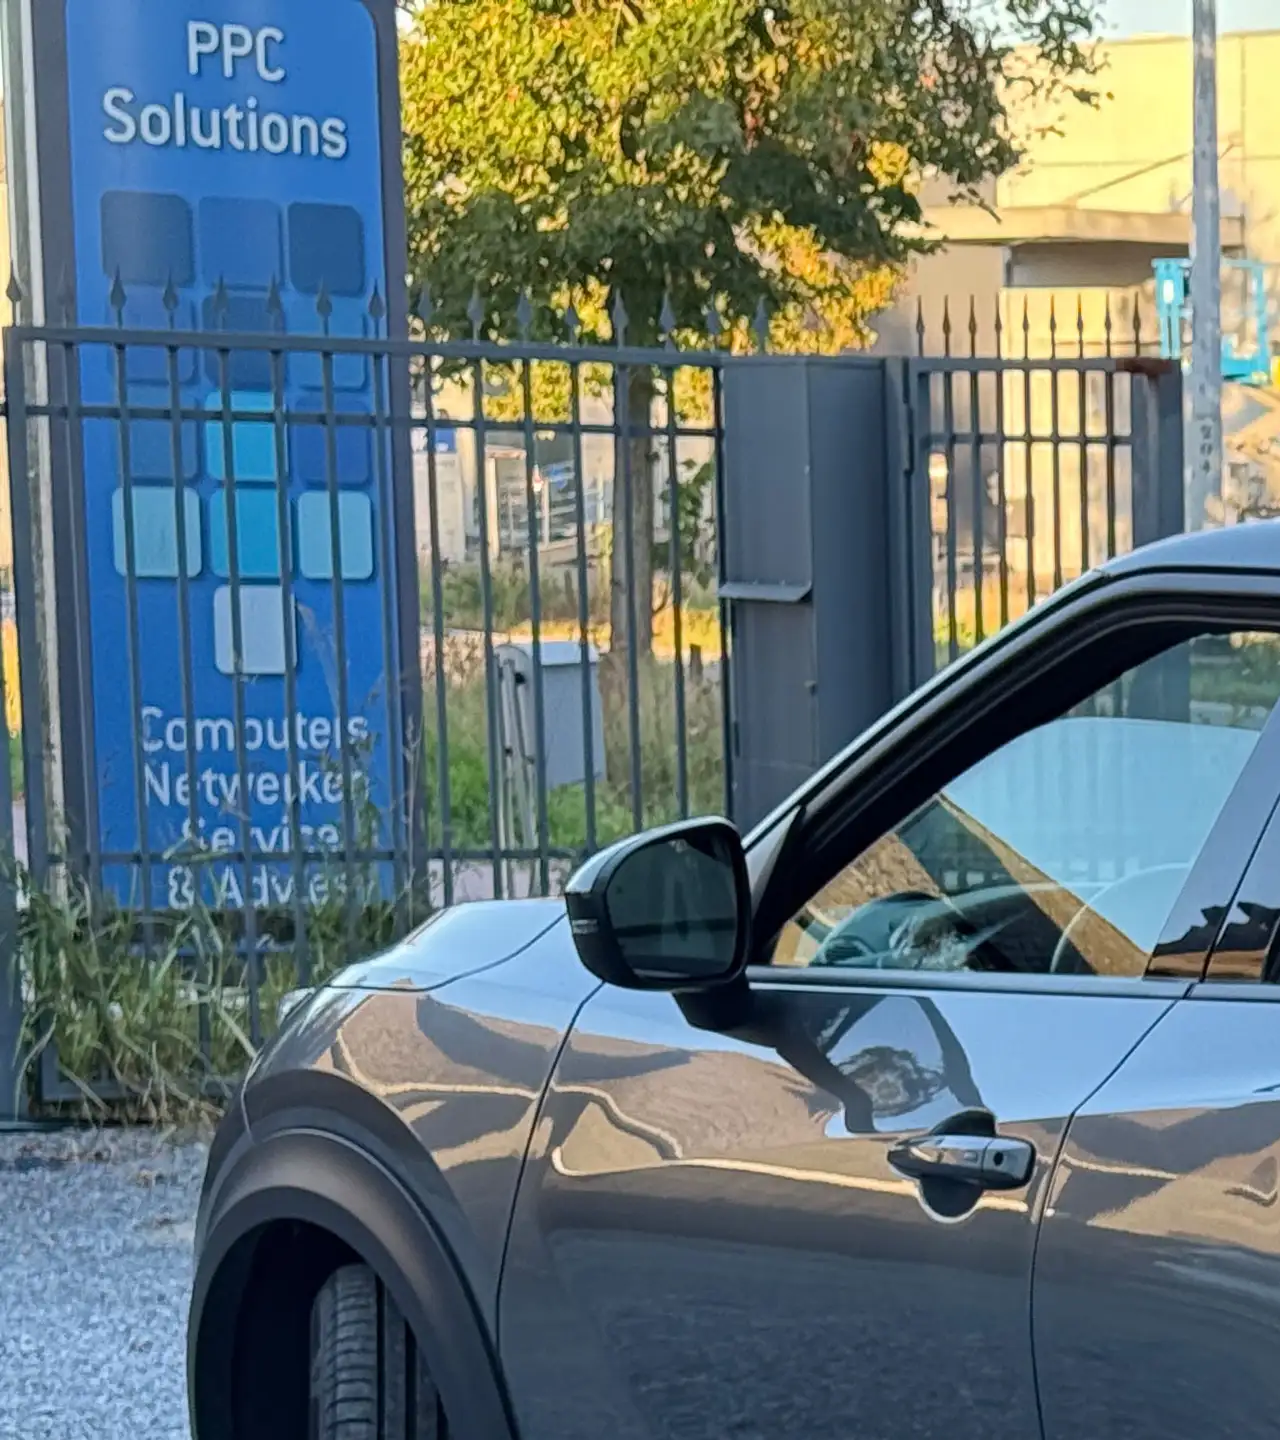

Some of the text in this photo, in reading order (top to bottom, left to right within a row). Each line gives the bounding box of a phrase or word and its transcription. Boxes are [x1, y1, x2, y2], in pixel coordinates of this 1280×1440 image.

[187, 20, 286, 82] PPC
[102, 87, 348, 158] Solutions
[141, 706, 368, 751] Computers
[168, 866, 195, 910] &
